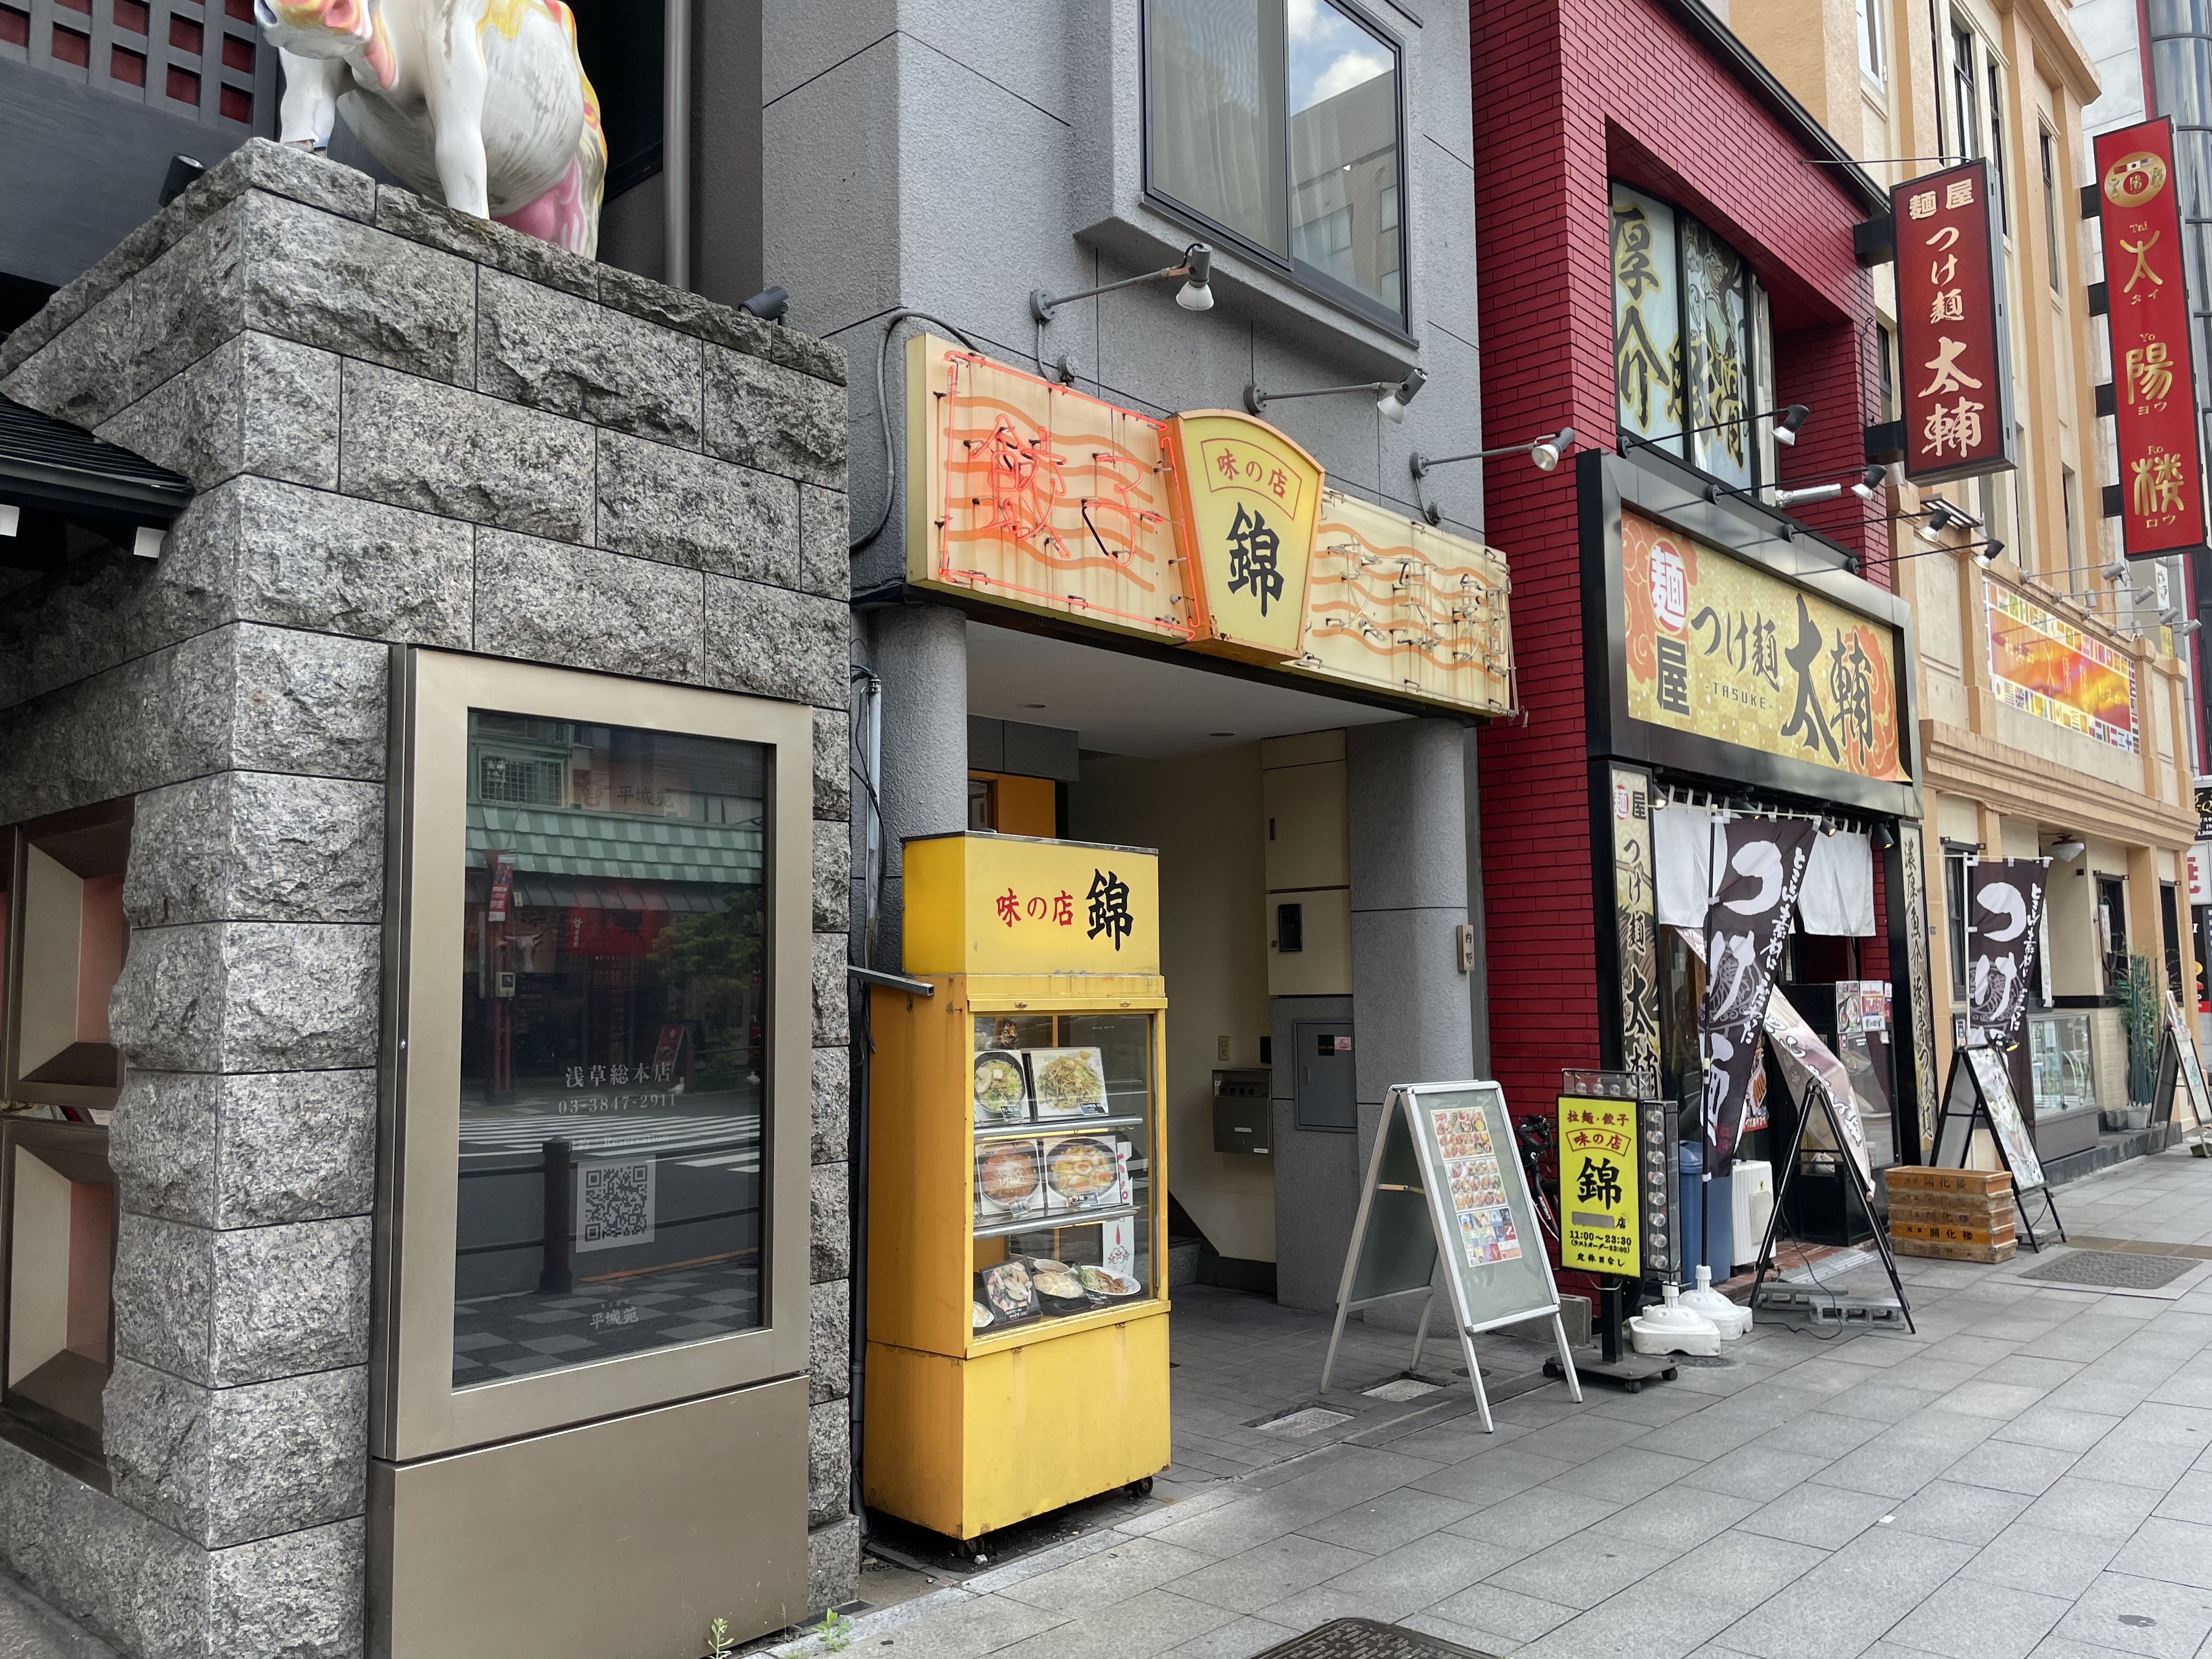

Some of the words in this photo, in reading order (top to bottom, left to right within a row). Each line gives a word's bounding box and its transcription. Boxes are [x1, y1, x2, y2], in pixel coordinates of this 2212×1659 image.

[1909, 179, 1974, 220] 麺屋
[2129, 221, 2148, 233] Tai
[1926, 227, 1964, 324] つけ麺
[2131, 289, 2158, 305] タイ
[2140, 333, 2155, 342] Yo
[2126, 342, 2173, 405] 陽
[1918, 336, 1984, 458] 太輔
[2138, 402, 2167, 415] ヨウ
[2148, 445, 2164, 455] Ro
[1216, 448, 1289, 499] 味の店
[969, 414, 1165, 567] 餃子
[2146, 515, 2176, 528] ロウ
[1226, 502, 1285, 618] 錦
[1651, 544, 1690, 716] 麺屋
[1691, 606, 1780, 692] つけ麺
[1615, 788, 1646, 819] 麺屋
[996, 887, 1074, 928] 味の店
[1086, 868, 1134, 951] 錦
[1623, 839, 1645, 952] つけ麺
[1465, 932, 1472, 964] 内野
[566, 1062, 672, 1088] 浅草総本店
[558, 1093, 675, 1114] 03-3847-2911
[1573, 1132, 1622, 1150] 味の店
[1577, 1156, 1622, 1210] 錦
[1616, 1216, 1626, 1229] 店
[1577, 1252, 1625, 1267] 定休日なし
[590, 1306, 638, 1330] 平城苑
